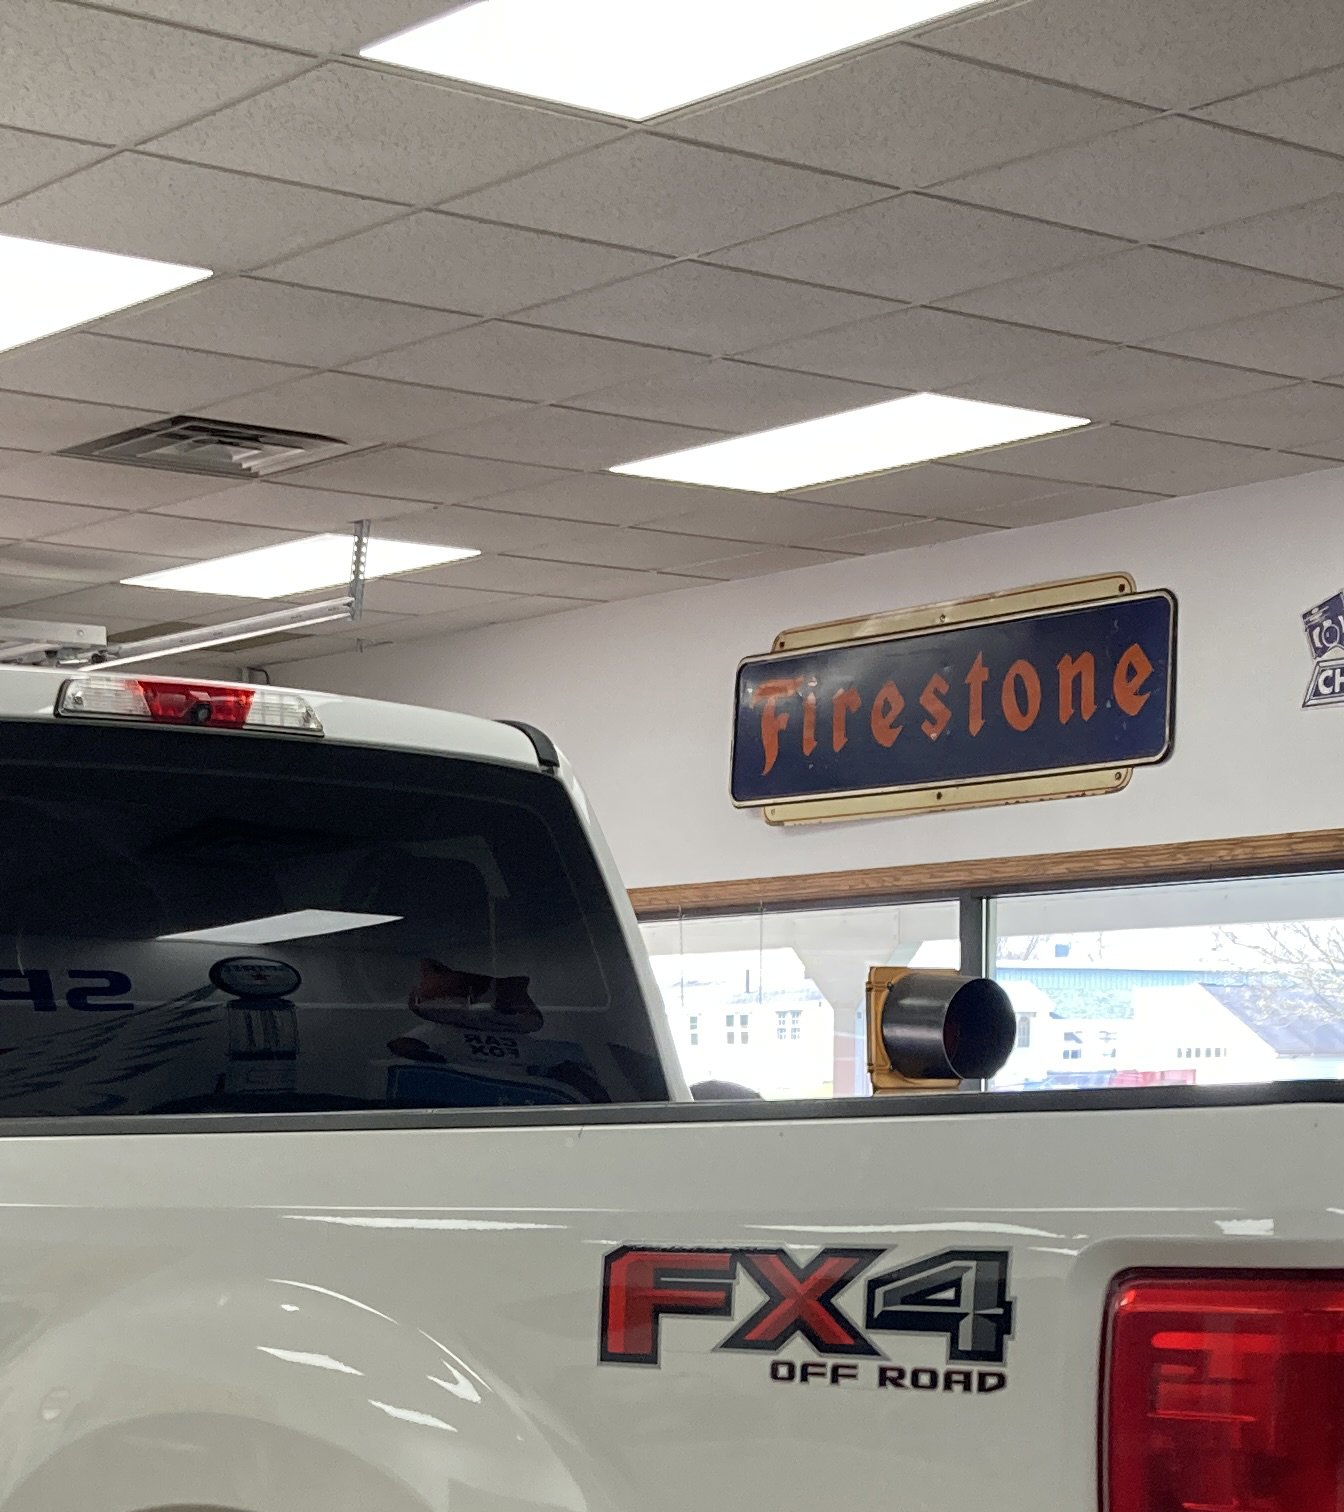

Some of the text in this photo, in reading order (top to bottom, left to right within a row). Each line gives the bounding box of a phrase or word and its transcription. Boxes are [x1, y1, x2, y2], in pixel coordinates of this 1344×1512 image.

[755, 642, 1155, 777] Firestone
[596, 1240, 1017, 1369] FX4
[769, 1359, 1008, 1394] OFF ROAD
